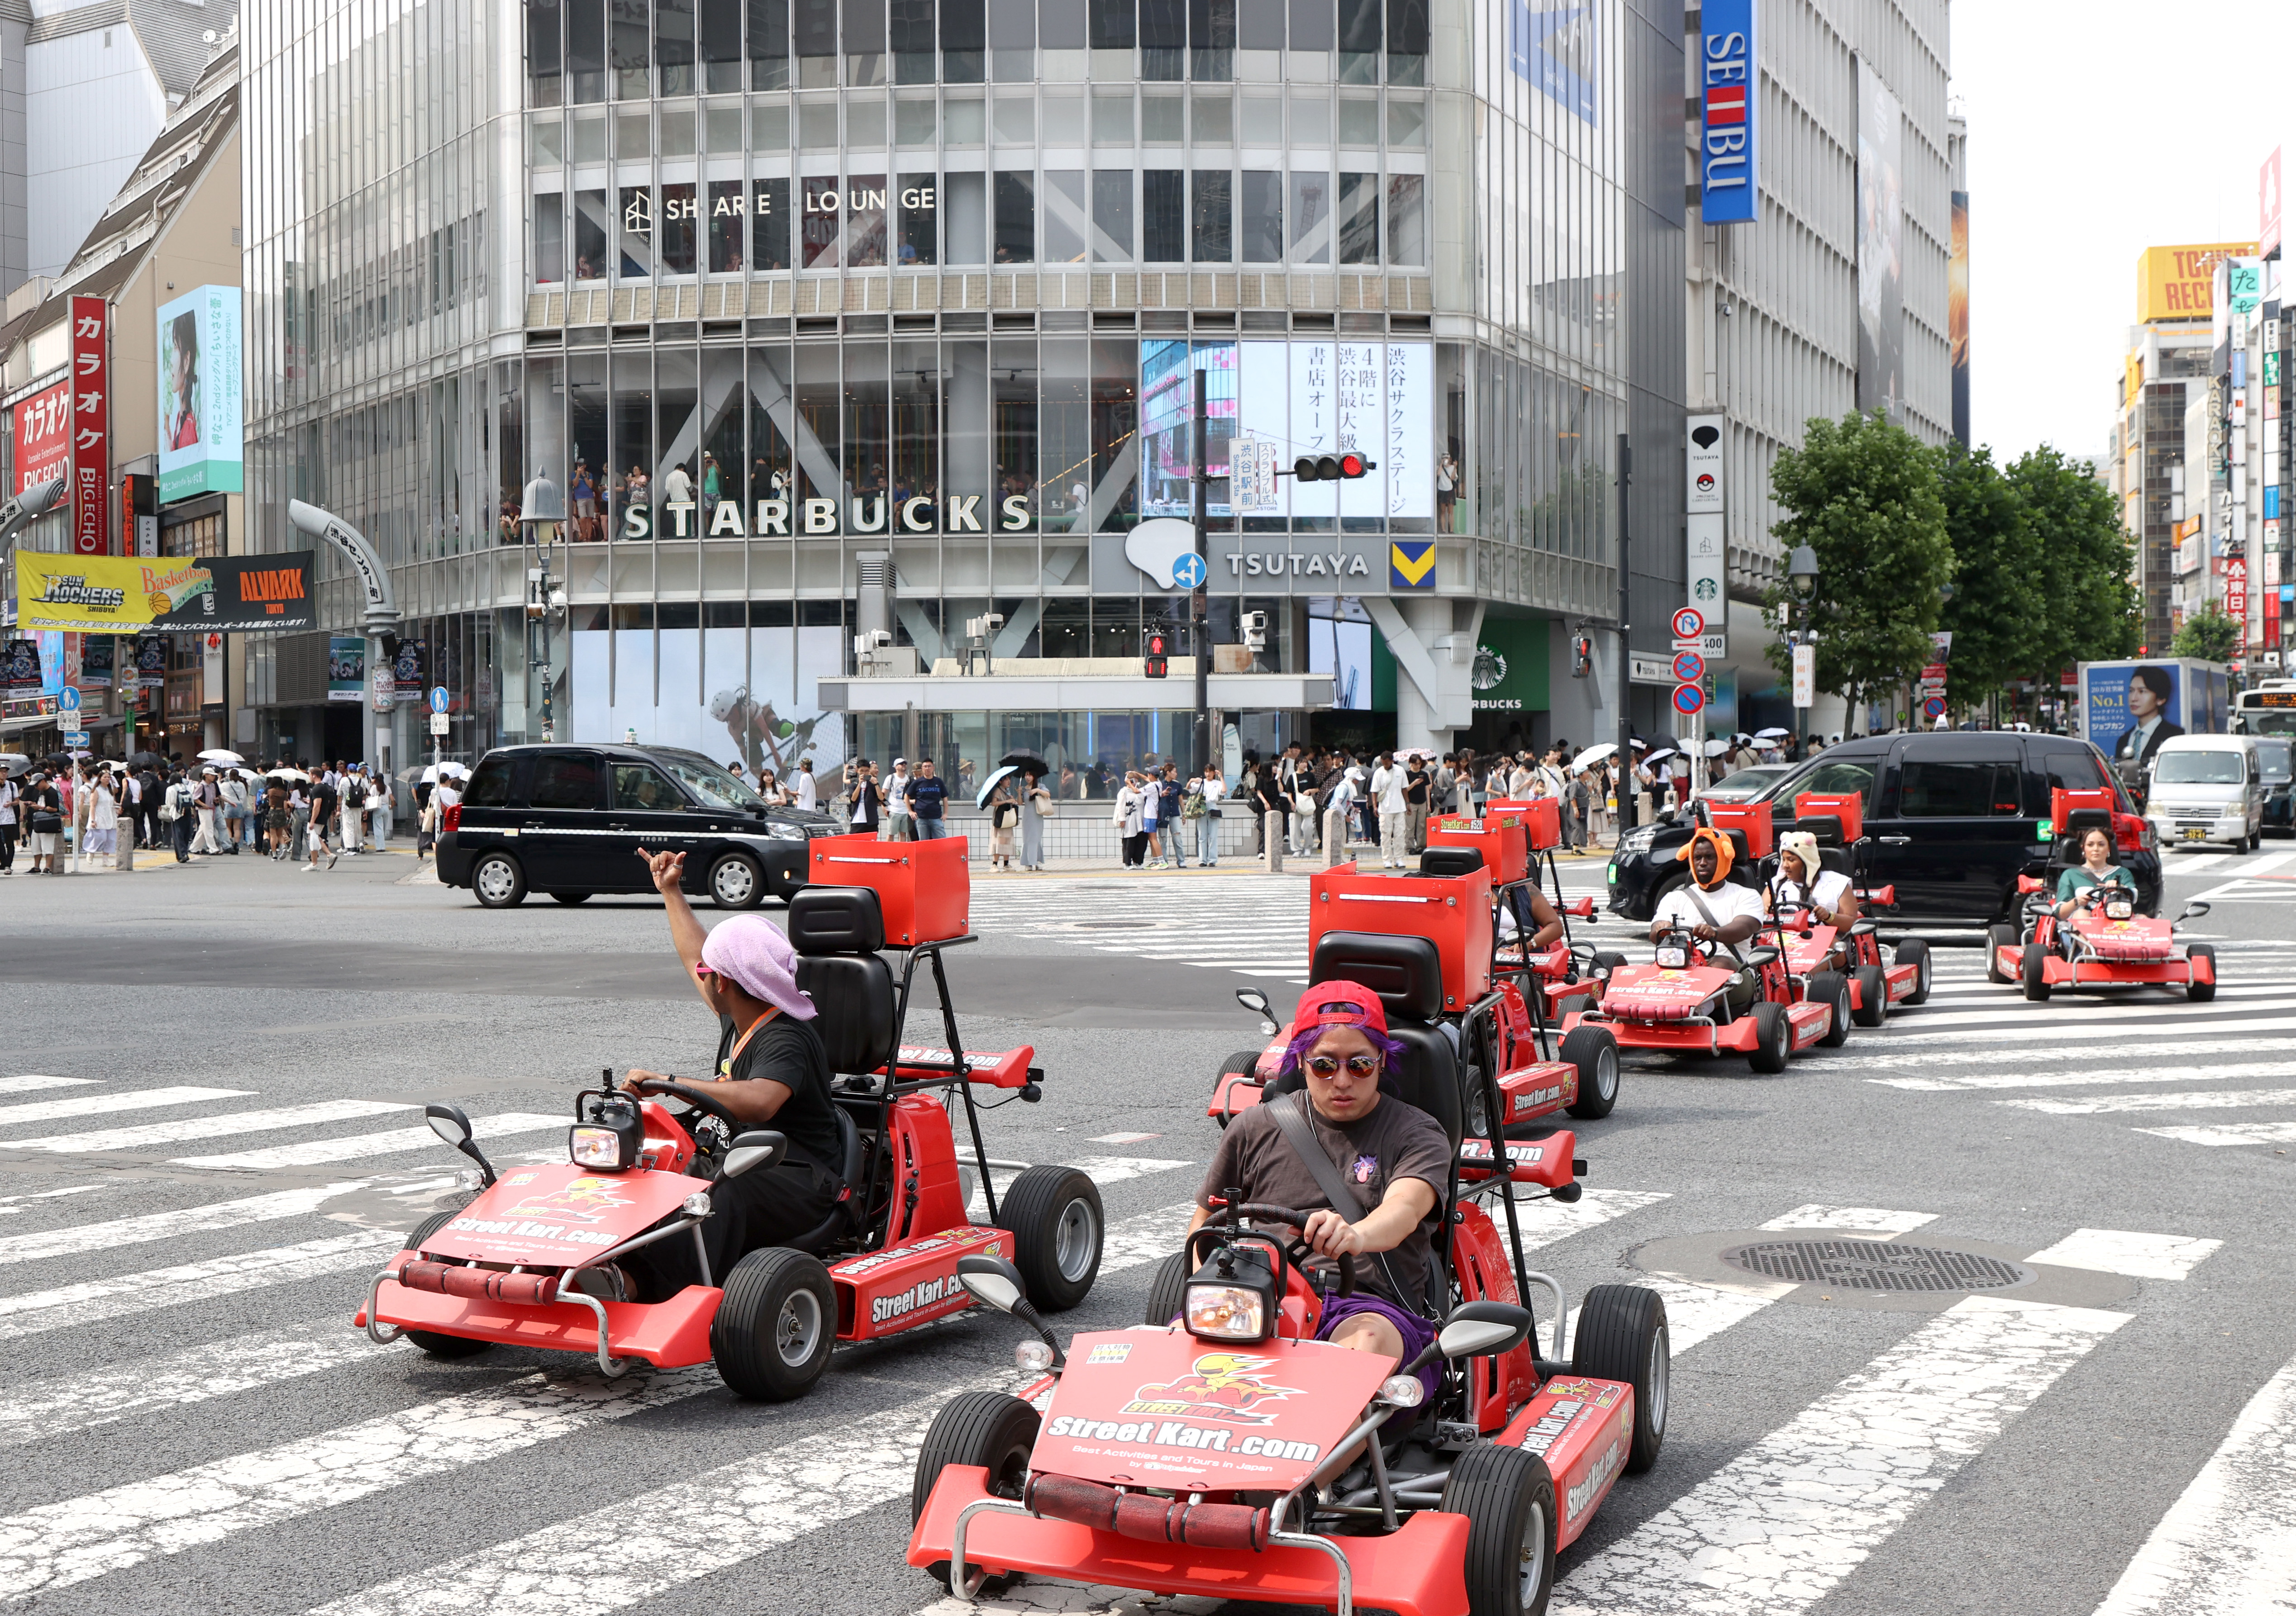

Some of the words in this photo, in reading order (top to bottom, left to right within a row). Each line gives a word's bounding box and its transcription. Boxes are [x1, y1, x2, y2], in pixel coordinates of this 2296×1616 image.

[1707, 32, 1746, 192] SEIBU
[666, 194, 771, 220] SHARE
[807, 188, 934, 212] LOUNGE
[76, 316, 104, 450] カラオケ
[1359, 348, 1377, 407] 4階に
[1339, 347, 1357, 451] 渋谷最大級
[24, 390, 69, 446] カラオケ
[1389, 347, 1406, 513] 渋谷サクラステージ
[2207, 375, 2223, 472] KARAOKE
[28, 452, 41, 465] Karaoke
[41, 441, 66, 459] Entertainment
[79, 467, 95, 500] BIG
[1241, 444, 1253, 506] 渋谷駅前
[1261, 445, 1271, 503] スクランブル式
[80, 504, 96, 551] ECHO
[624, 495, 1031, 538] STARBUCKS
[2219, 489, 2233, 557] カラオケ
[330, 527, 378, 599] 渋谷センター街
[1226, 553, 1370, 575] TSUTAYA
[30, 574, 125, 606] ROCKERS
[61, 575, 85, 586] SUN
[139, 565, 213, 594] Basketball
[239, 568, 305, 601] ALVARK
[265, 604, 284, 614] TOKYO
[1796, 650, 1805, 702] 公園通り
[1472, 699, 1522, 709] RBUCKS
[2092, 694, 2125, 708] No.1
[1471, 819, 1482, 830] #528
[898, 1047, 922, 1060] eet
[1515, 1092, 1534, 1111] Street
[1461, 1142, 1543, 1161] rt.com
[447, 1218, 515, 1238] Street
[474, 1237, 508, 1245] Activities
[872, 1286, 915, 1323] Street
[916, 1273, 964, 1308] Kart.co
[875, 1323, 886, 1331] Best
[886, 1318, 905, 1328] Activities
[914, 1310, 925, 1319] Tours
[929, 1303, 940, 1313] Japan
[1047, 1416, 1155, 1444] Street
[1520, 1432, 1557, 1458] reet
[1546, 1452, 1558, 1464] Best
[1552, 1441, 1566, 1457] Activities
[1566, 1428, 1575, 1440] Tours
[1573, 1420, 1582, 1431] Japan
[1072, 1445, 1100, 1455] Best
[1102, 1448, 1158, 1461] Activities
[1161, 1454, 1183, 1463] and
[1186, 1455, 1219, 1467] Tours
[1222, 1459, 1233, 1469] in
[1236, 1461, 1273, 1473] Japan
[1129, 1460, 1142, 1469] by
[1567, 1469, 1592, 1522] Street
